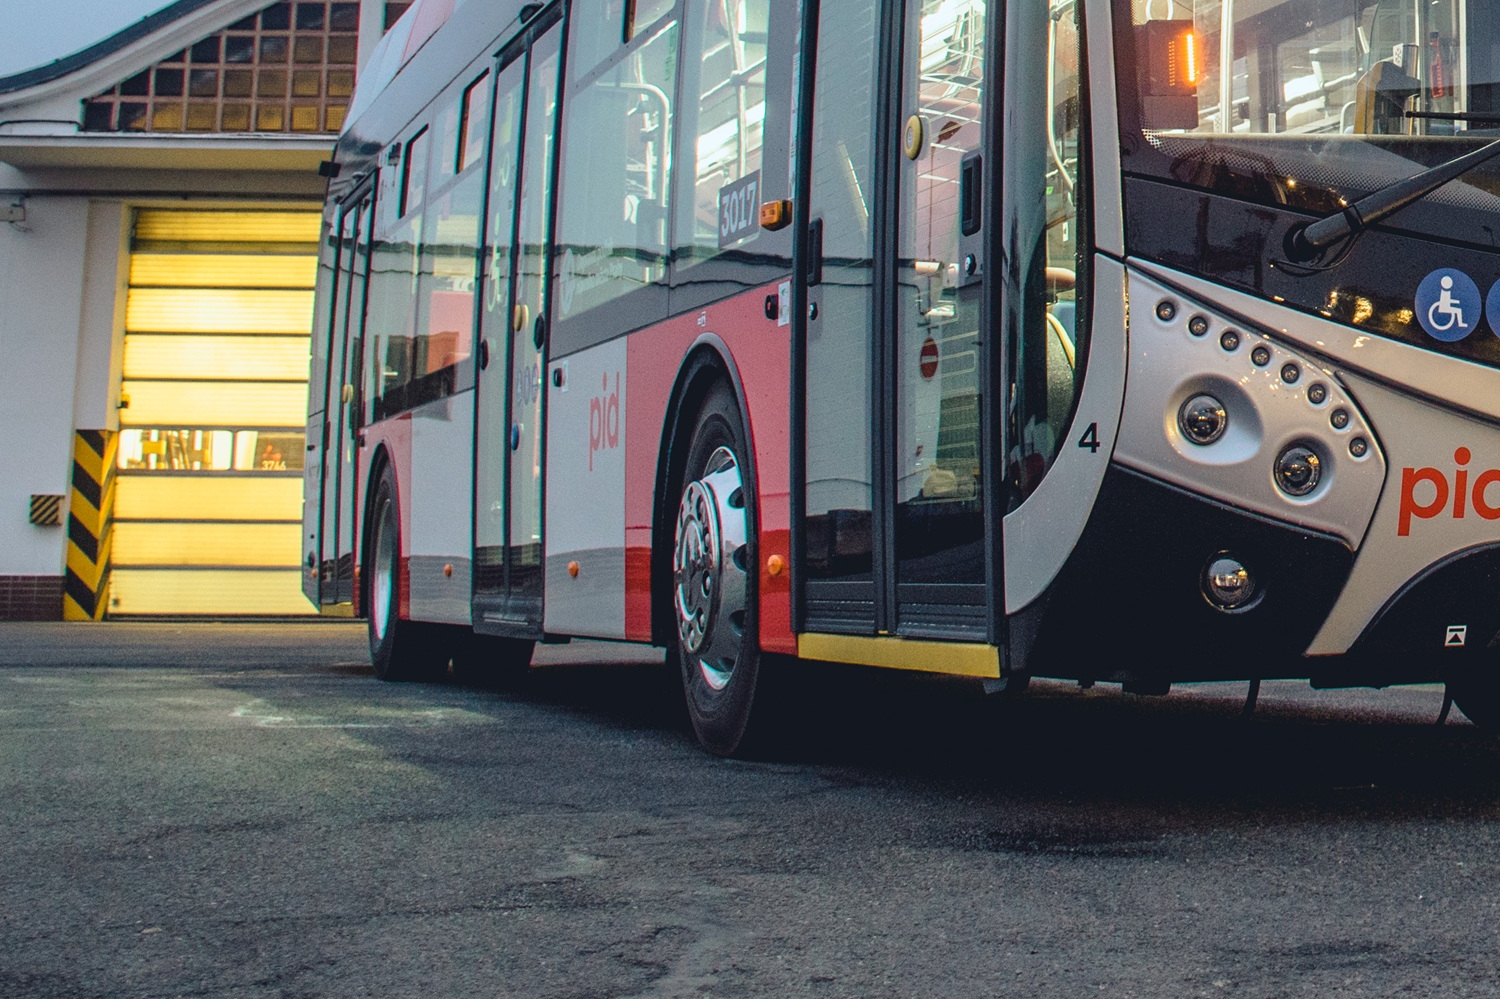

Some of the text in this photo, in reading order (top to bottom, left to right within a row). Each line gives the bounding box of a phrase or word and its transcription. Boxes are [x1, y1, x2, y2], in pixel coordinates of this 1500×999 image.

[721, 181, 757, 237] 3017
[589, 371, 619, 472] pid
[1078, 422, 1101, 453] 4
